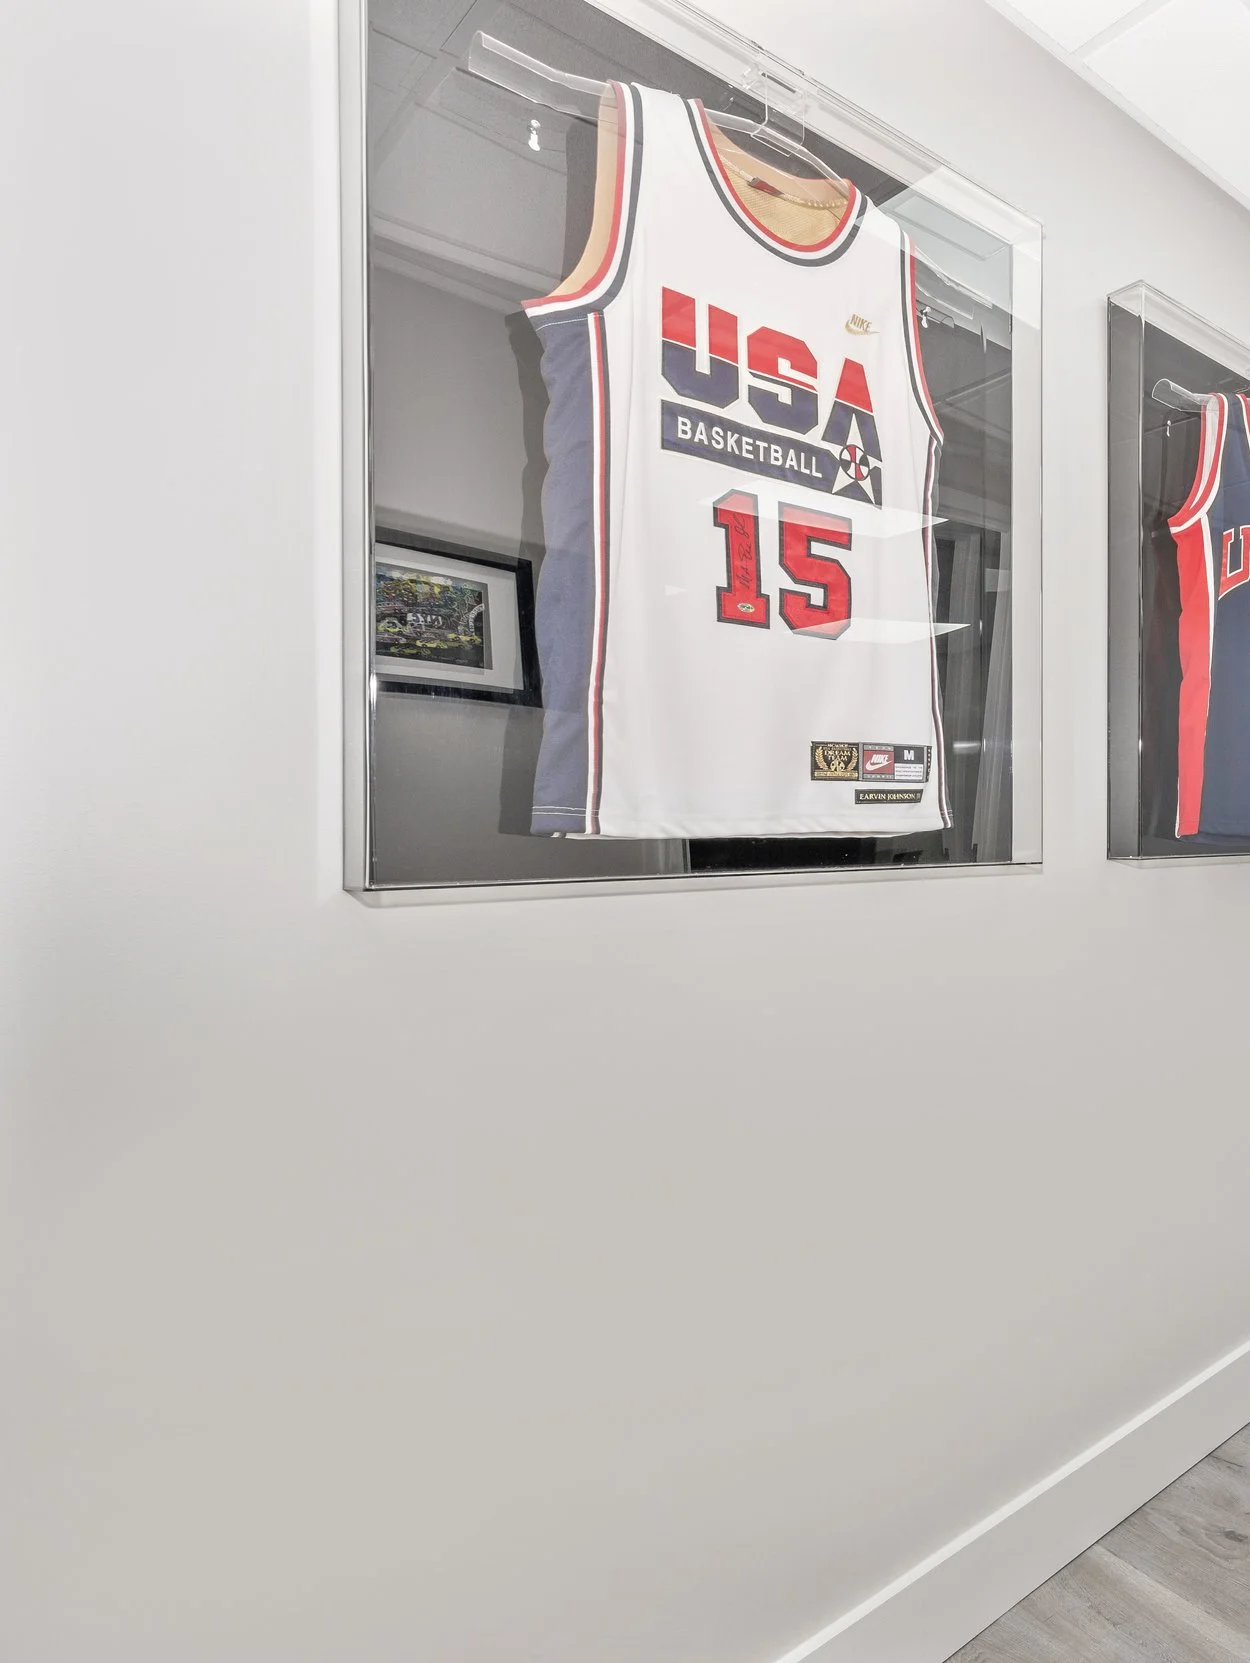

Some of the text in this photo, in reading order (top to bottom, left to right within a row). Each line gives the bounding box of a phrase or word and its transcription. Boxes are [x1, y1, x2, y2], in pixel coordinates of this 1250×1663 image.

[850, 313, 872, 333] NIKE
[661, 286, 882, 466] USA
[677, 415, 823, 479] BASKETBALL
[712, 488, 853, 641] 15
[871, 754, 889, 763] NIKE
[903, 749, 915, 761] M
